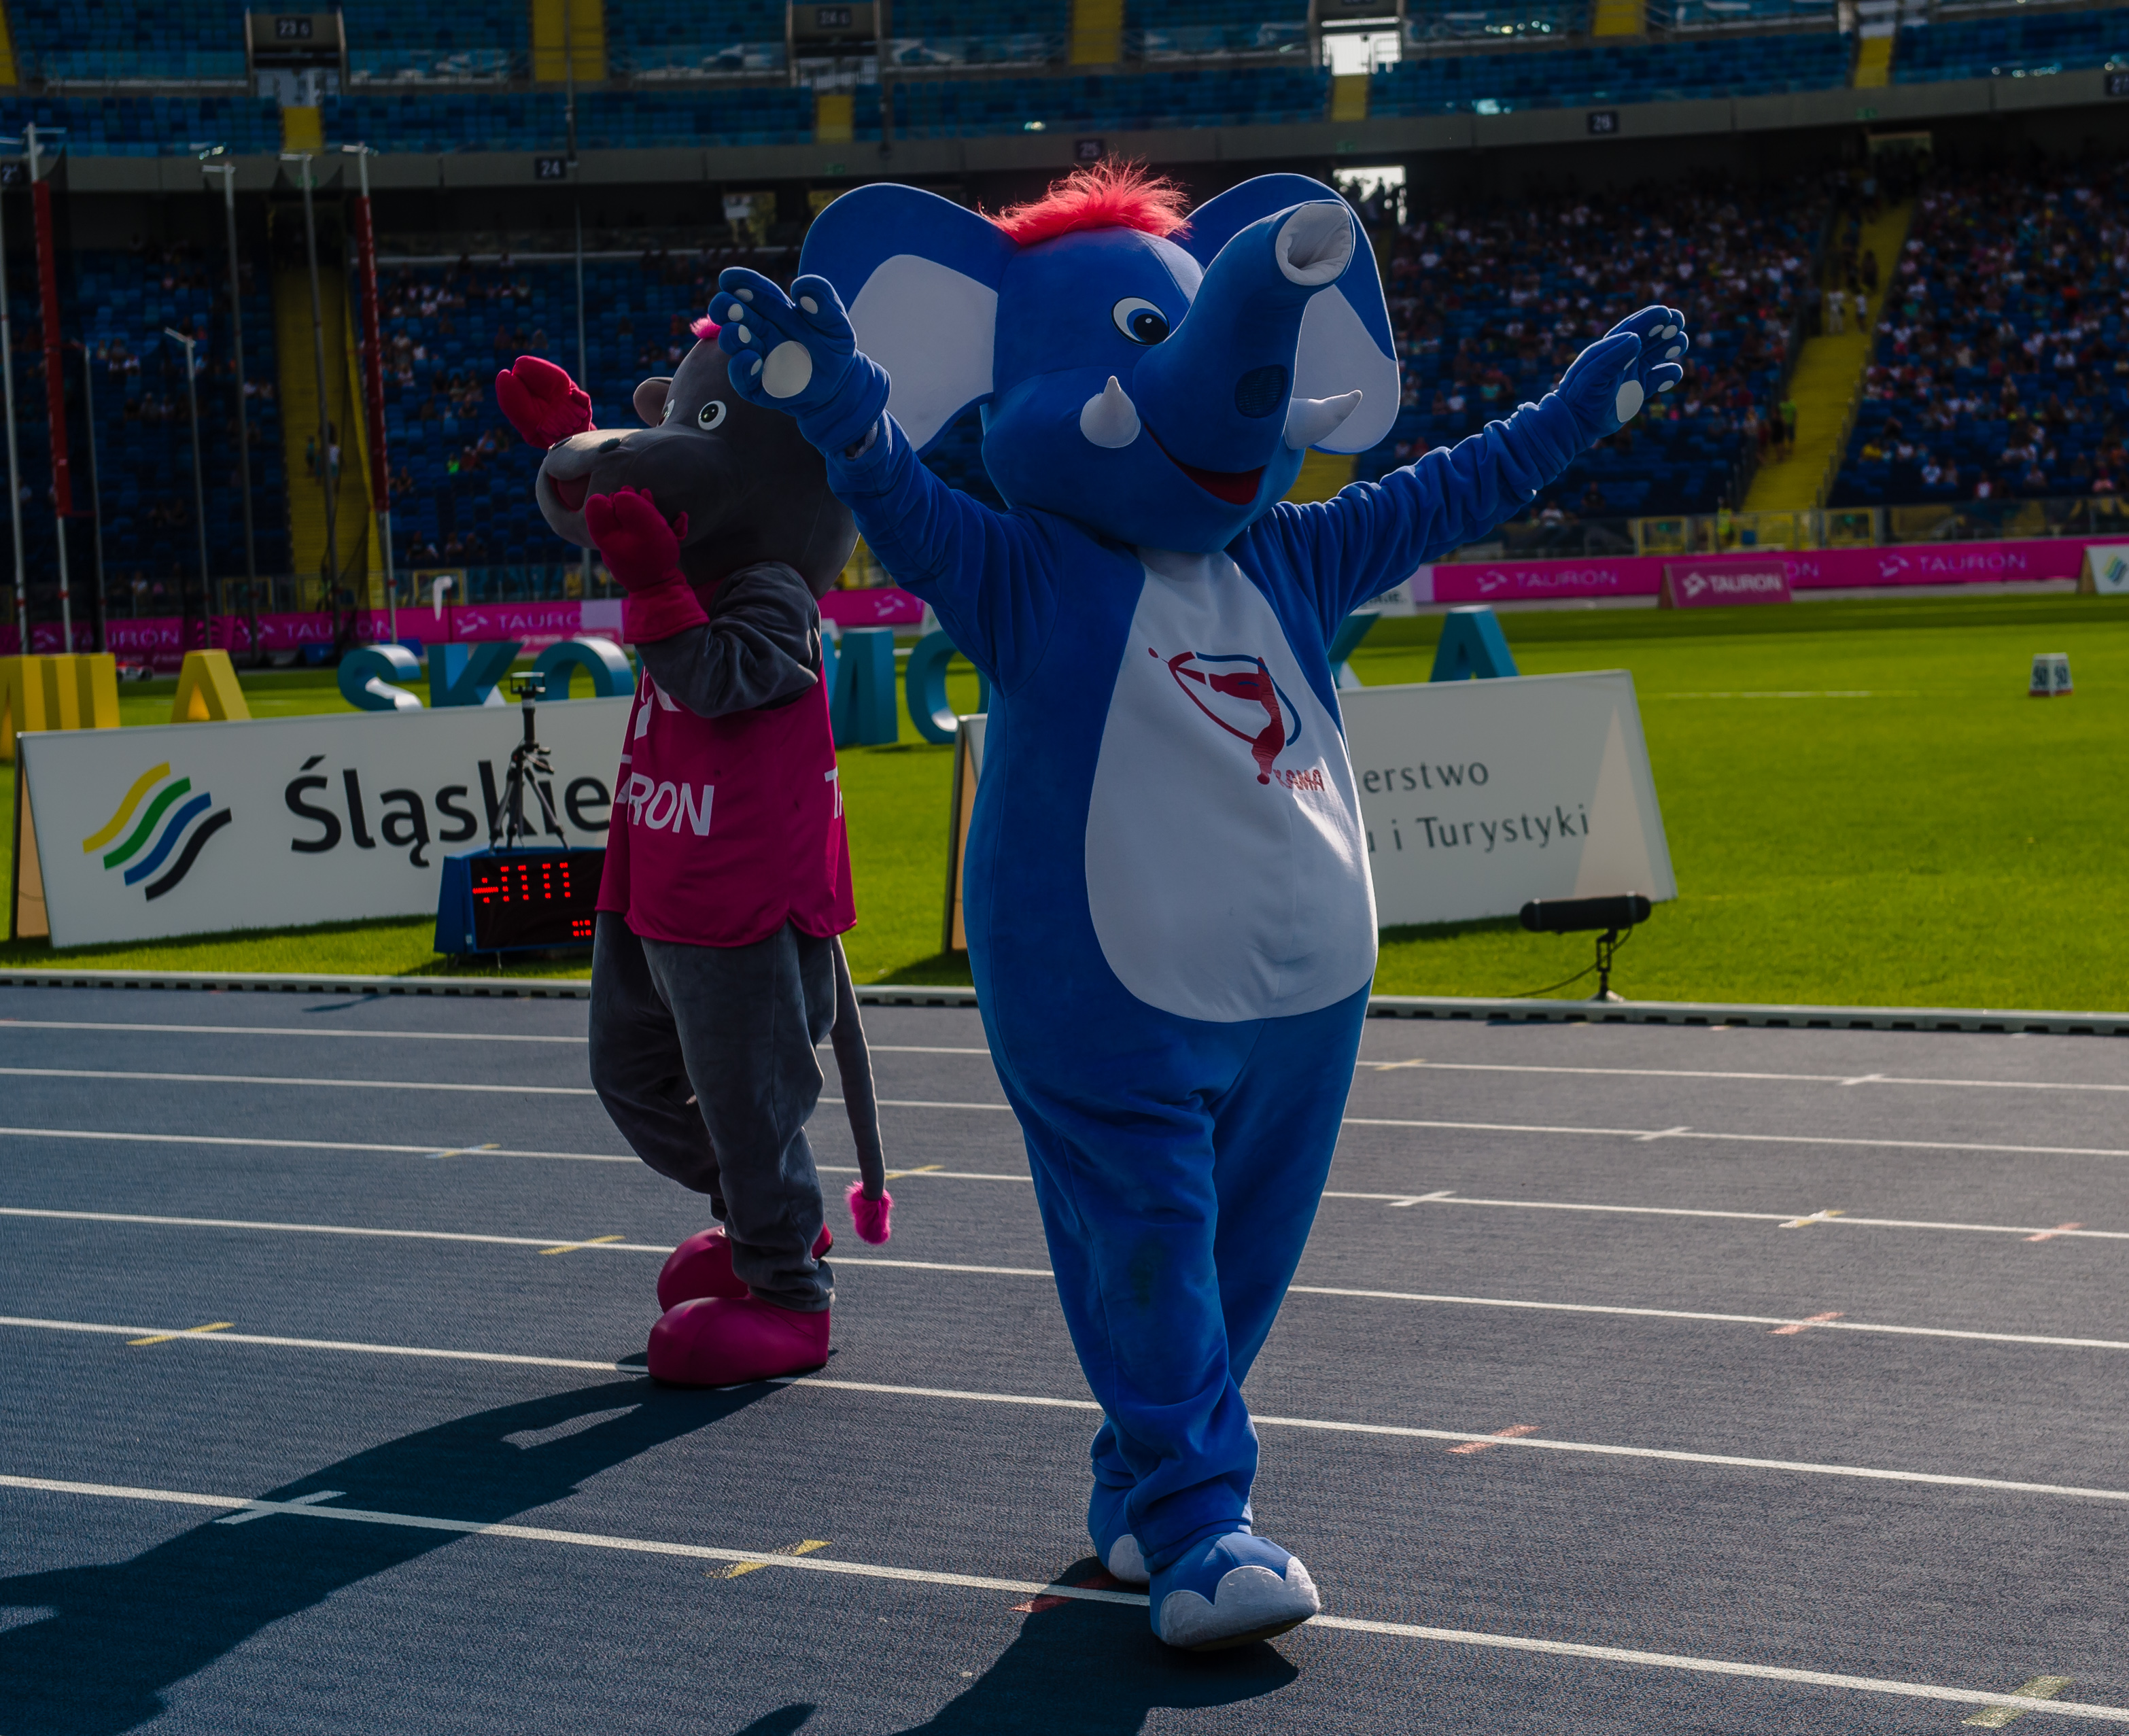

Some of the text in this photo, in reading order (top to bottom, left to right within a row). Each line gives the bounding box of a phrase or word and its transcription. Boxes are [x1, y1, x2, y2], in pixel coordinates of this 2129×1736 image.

[540, 159, 560, 177] 24
[1920, 553, 2026, 572] TAURON
[1515, 570, 1618, 587] TAURON
[1708, 573, 1782, 594] TAURON
[283, 619, 392, 638] TAUON
[1362, 761, 1489, 794] erstwo
[1391, 818, 1402, 851] i
[1416, 803, 1589, 854] Turystyki
